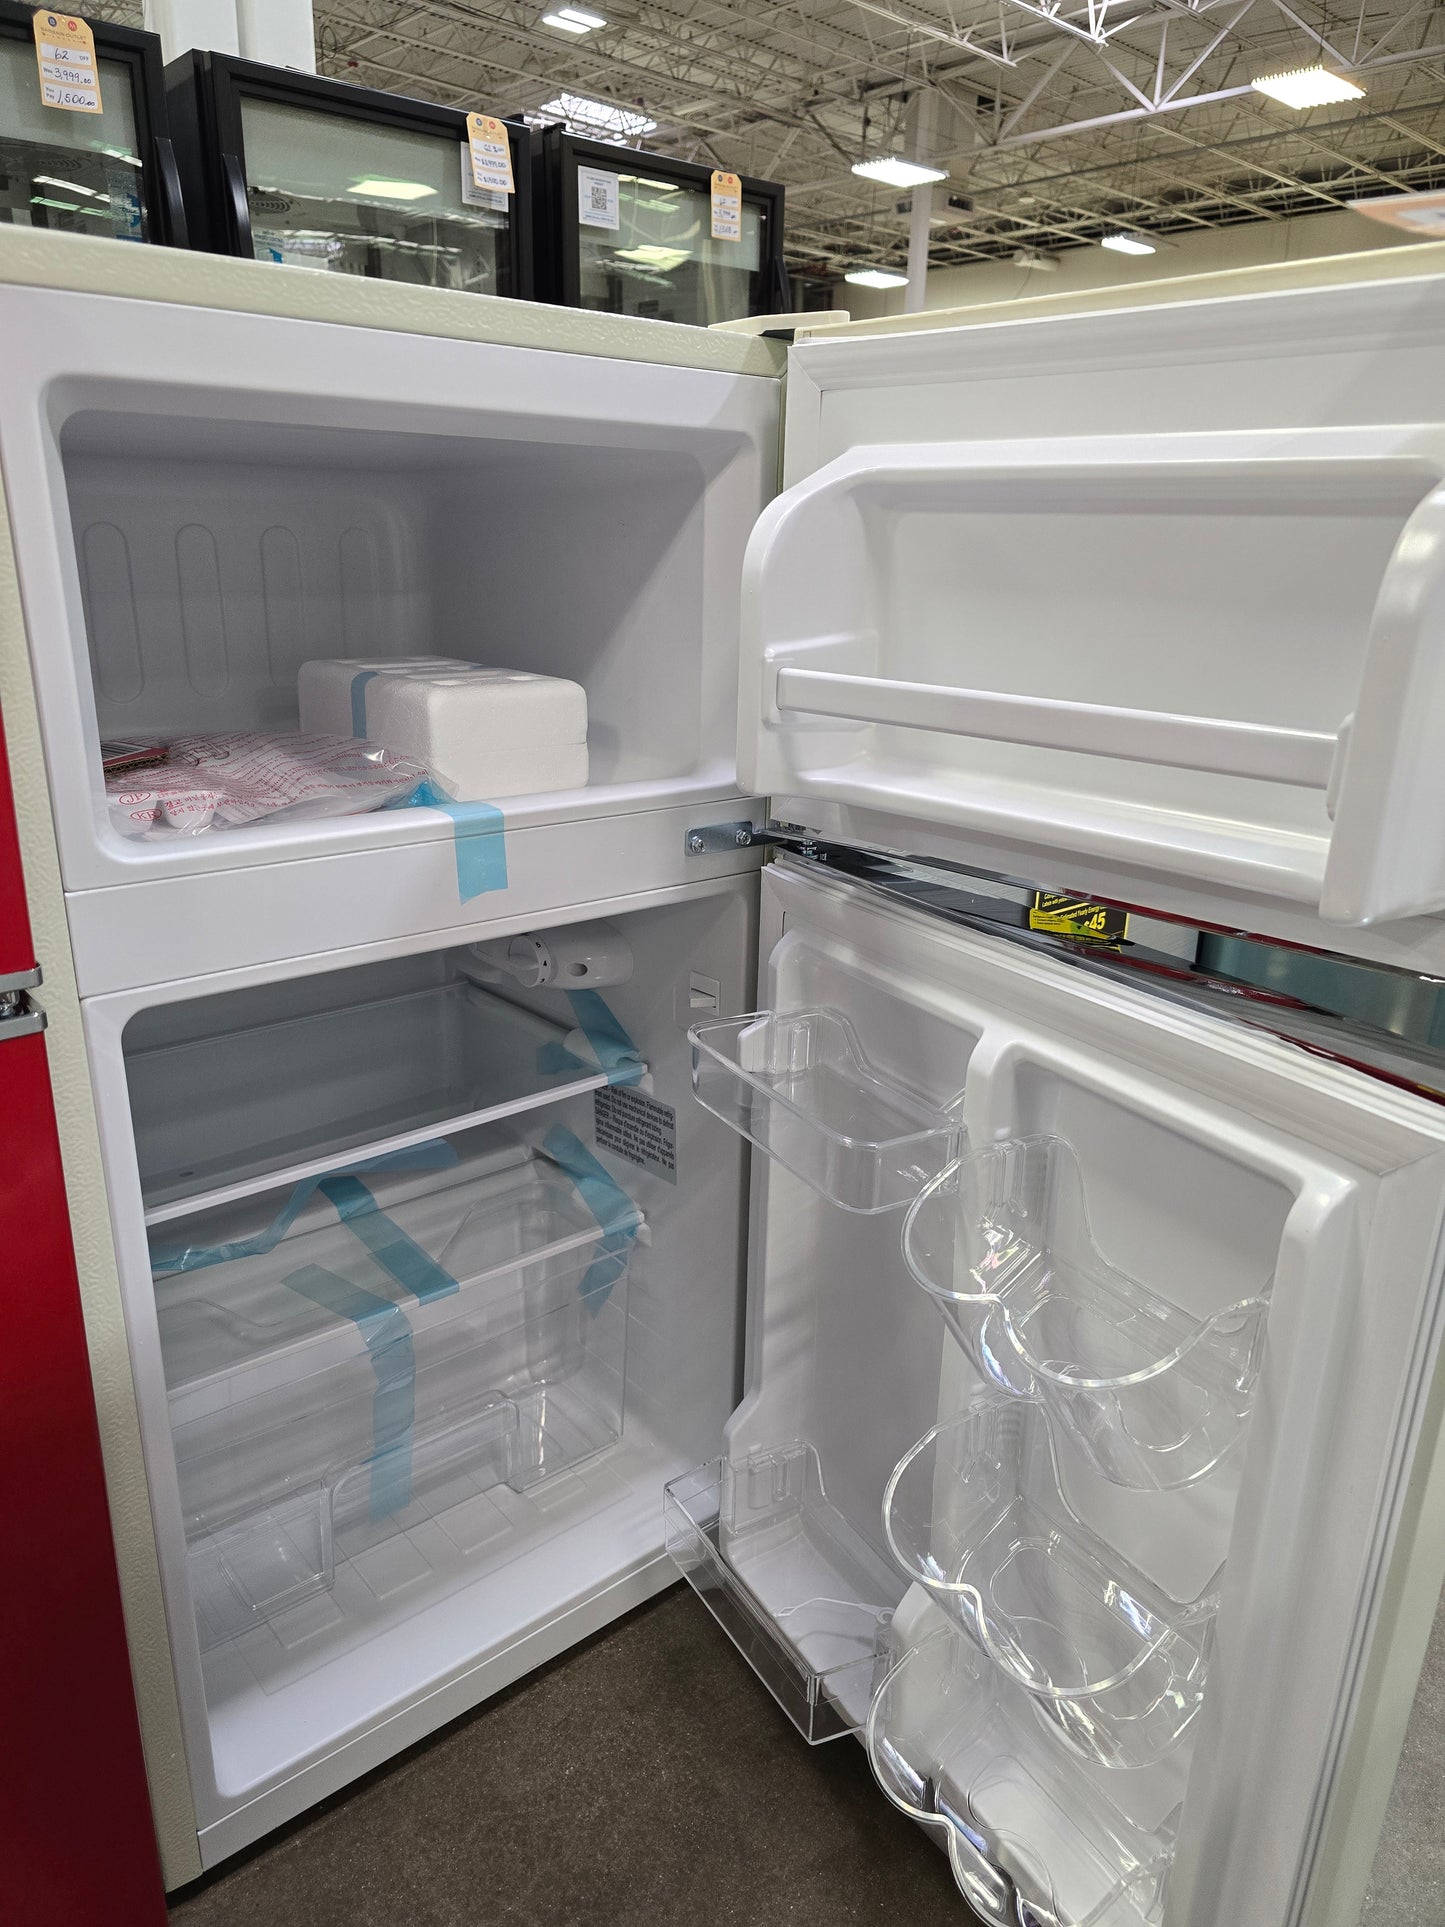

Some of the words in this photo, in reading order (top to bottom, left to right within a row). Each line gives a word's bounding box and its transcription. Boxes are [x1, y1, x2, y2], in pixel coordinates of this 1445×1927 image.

[54, 48, 70, 61] 62
[126, 793, 143, 803] JP
[136, 810, 157, 820] KR
